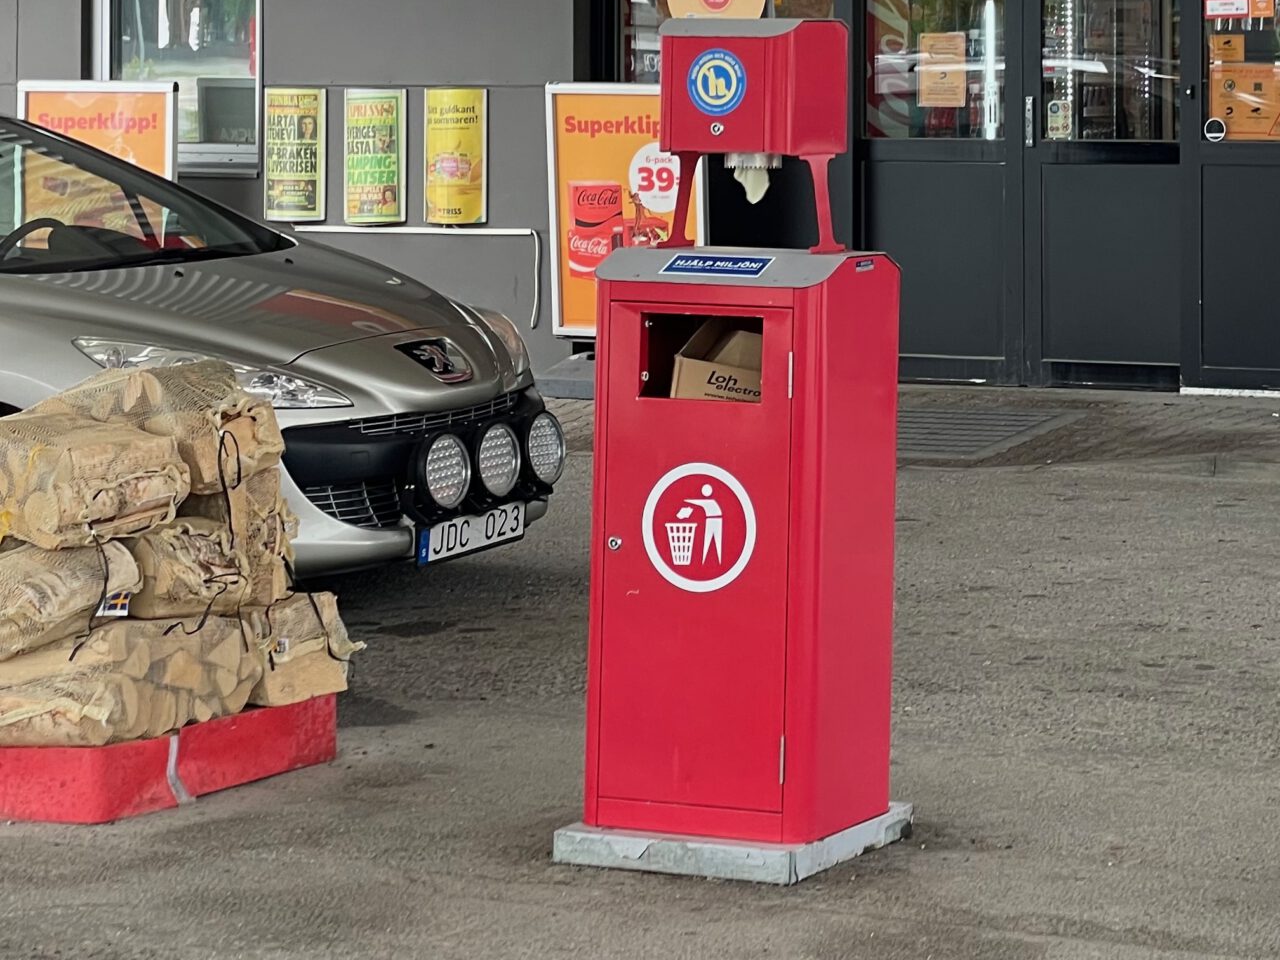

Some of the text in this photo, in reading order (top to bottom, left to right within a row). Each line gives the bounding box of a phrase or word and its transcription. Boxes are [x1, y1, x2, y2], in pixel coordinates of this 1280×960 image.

[38, 111, 157, 134] Superklipp!
[564, 115, 661, 138] Superklip
[638, 166, 680, 193] 39:
[675, 258, 714, 267] HJÄLP
[714, 260, 763, 269] MILJÖN!
[421, 505, 520, 557] S JDC 023
